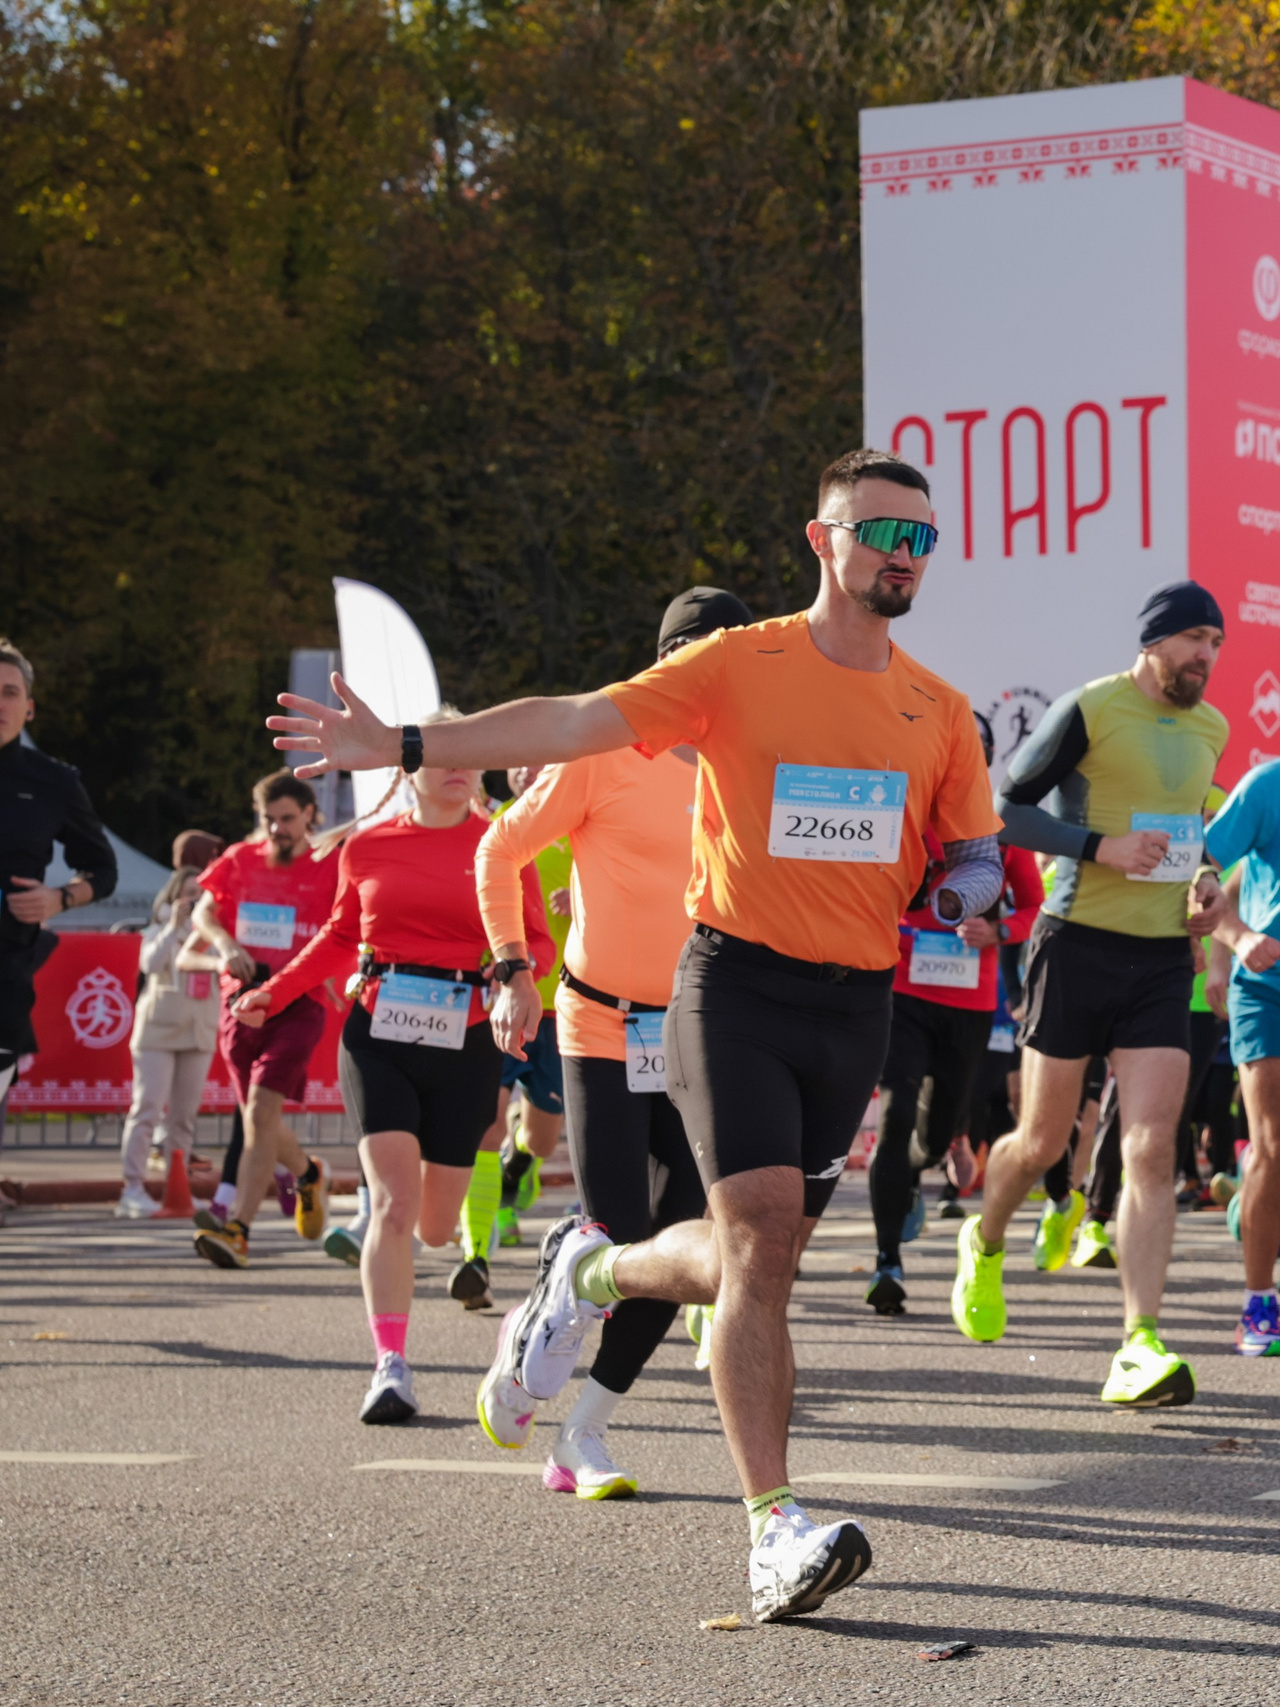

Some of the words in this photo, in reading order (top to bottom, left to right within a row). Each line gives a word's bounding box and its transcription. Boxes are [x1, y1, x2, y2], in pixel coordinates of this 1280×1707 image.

[785, 815, 873, 841] 22668
[1162, 851, 1191, 868] 829
[381, 1007, 448, 1033] 20646
[636, 1055, 665, 1074] 20
